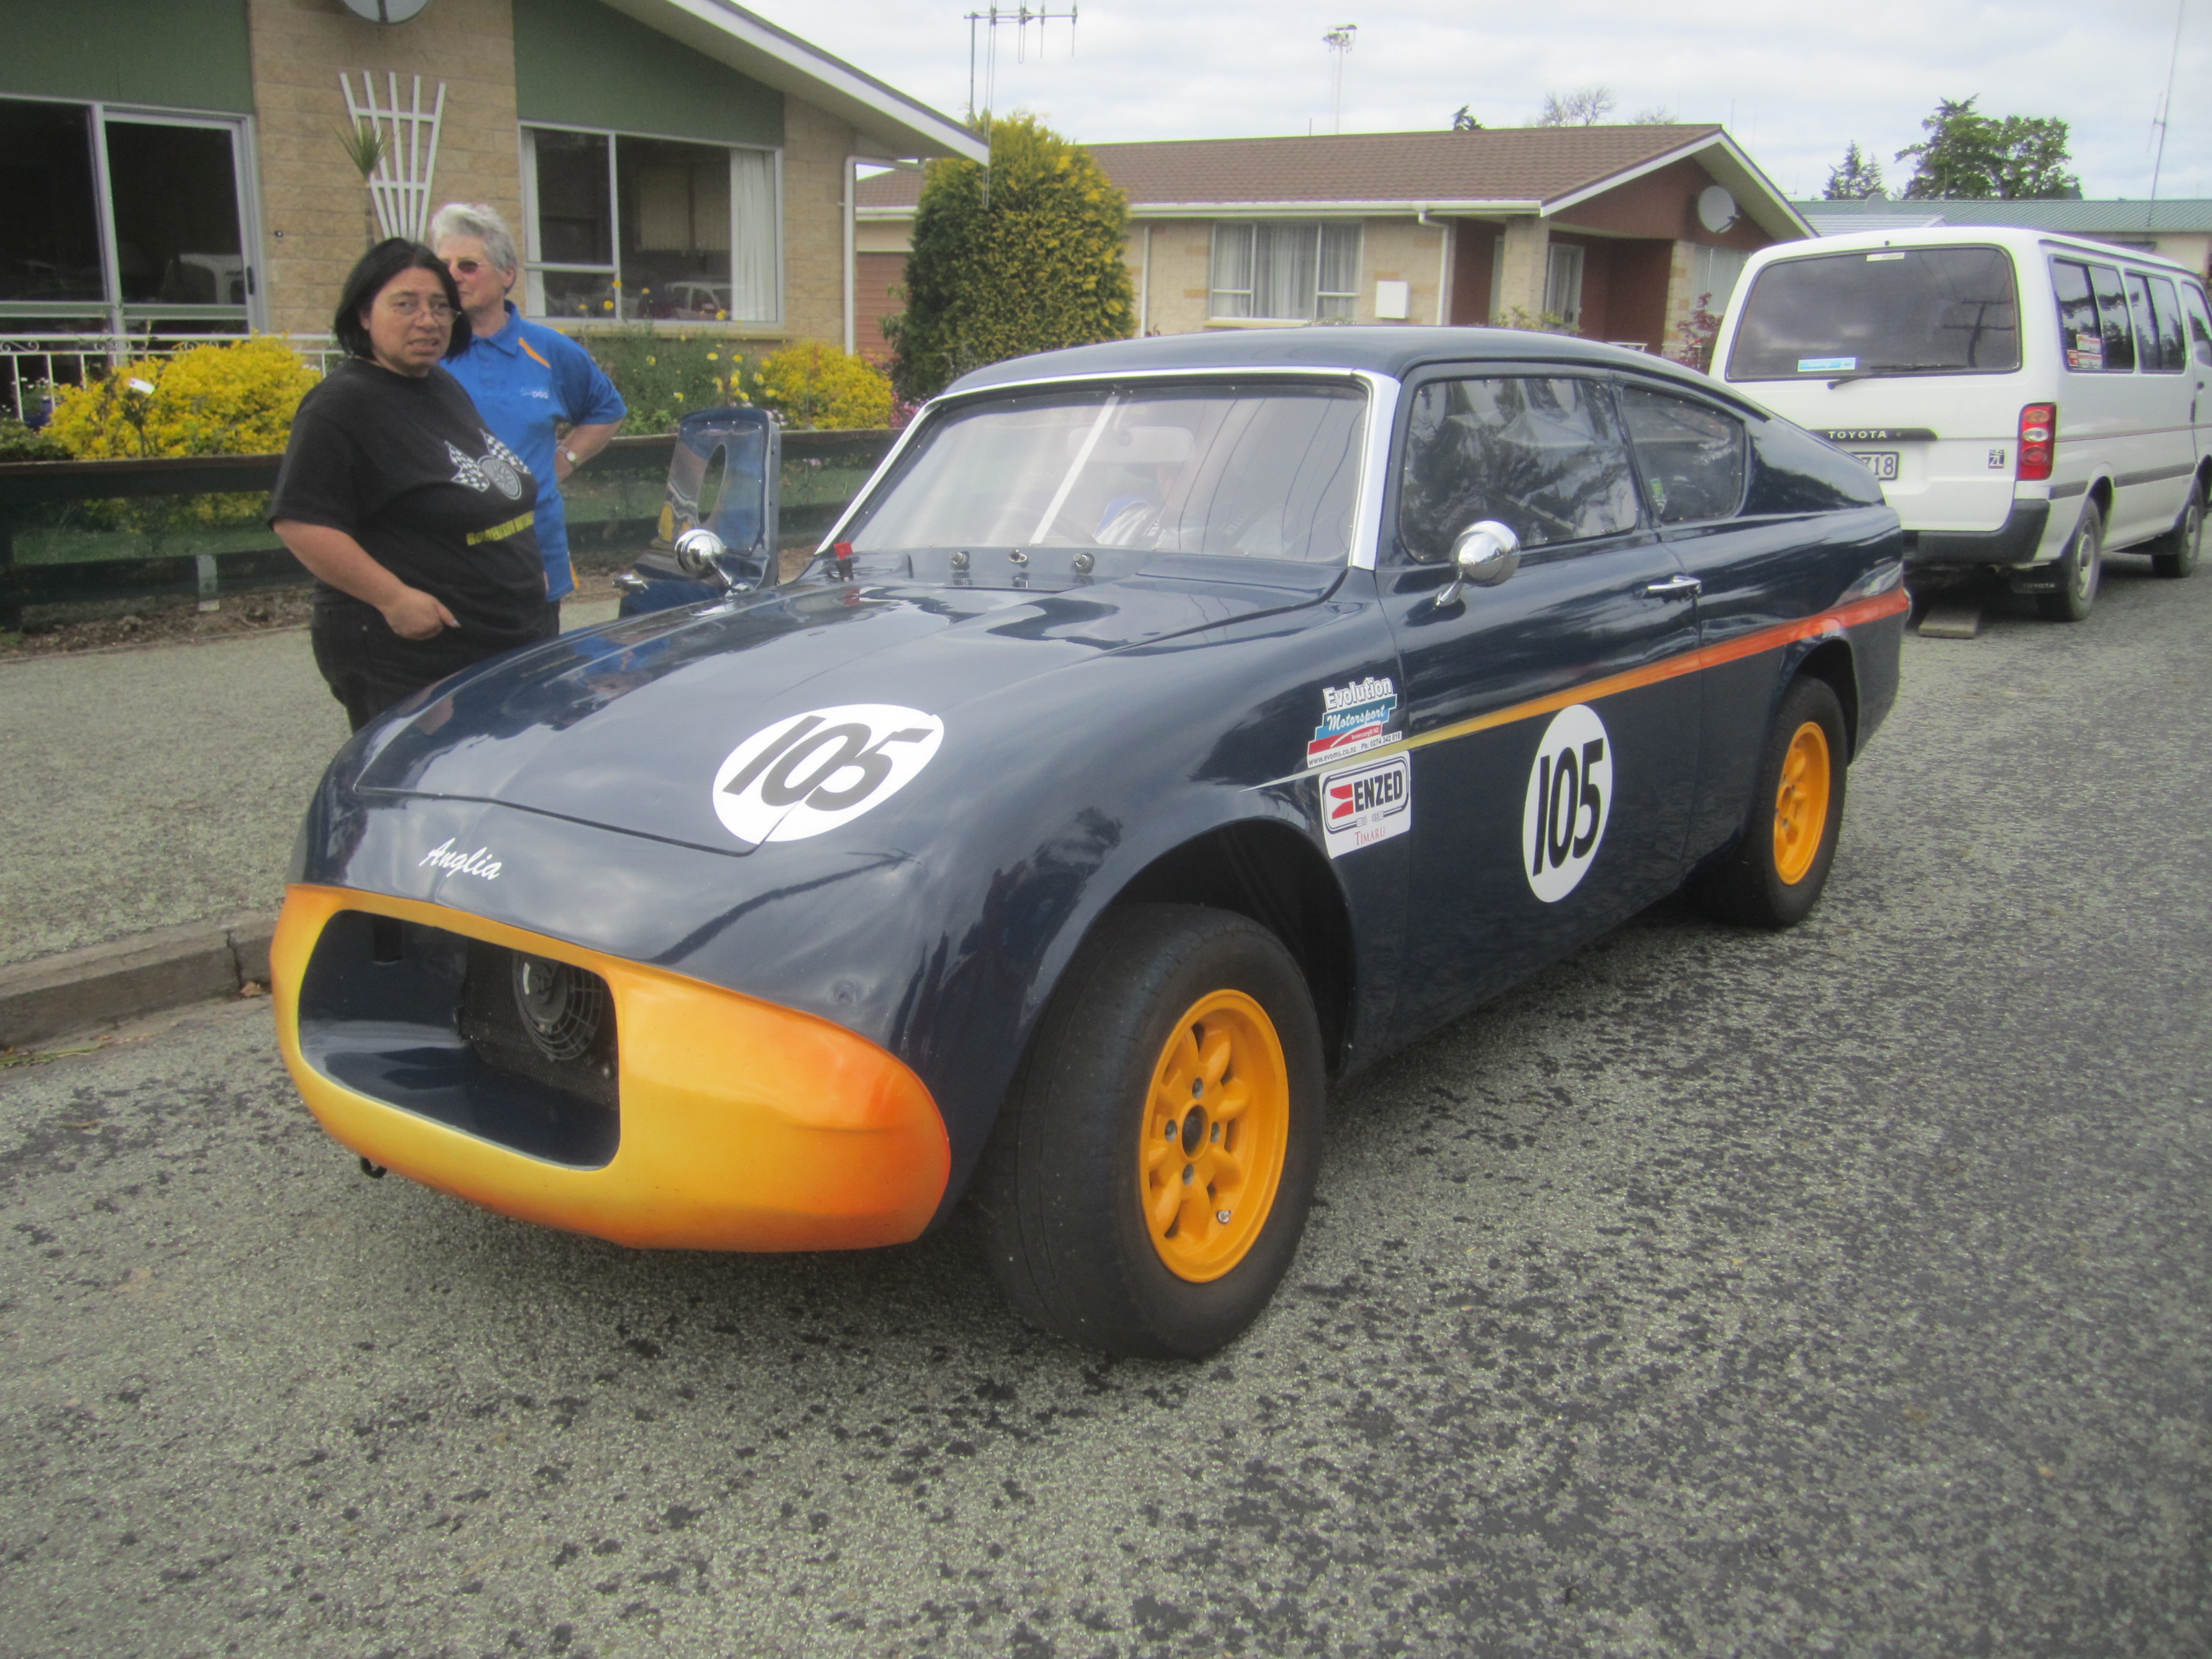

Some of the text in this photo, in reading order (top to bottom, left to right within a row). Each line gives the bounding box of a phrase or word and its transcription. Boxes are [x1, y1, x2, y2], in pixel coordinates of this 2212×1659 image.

[1828, 430, 1887, 439] TOYOTA
[1323, 677, 1393, 710] Evolution
[1327, 705, 1385, 731] Motorsport
[722, 715, 935, 812] 105
[1308, 746, 1356, 766] www.evoms.co.nz
[1370, 738, 1382, 747] 0274
[1382, 735, 1391, 743] 342
[1392, 732, 1401, 741] 018
[1354, 770, 1403, 813] ENZED
[1532, 737, 1604, 877] 105
[1354, 826, 1385, 846] TIMARU
[419, 837, 502, 880] Anglia
